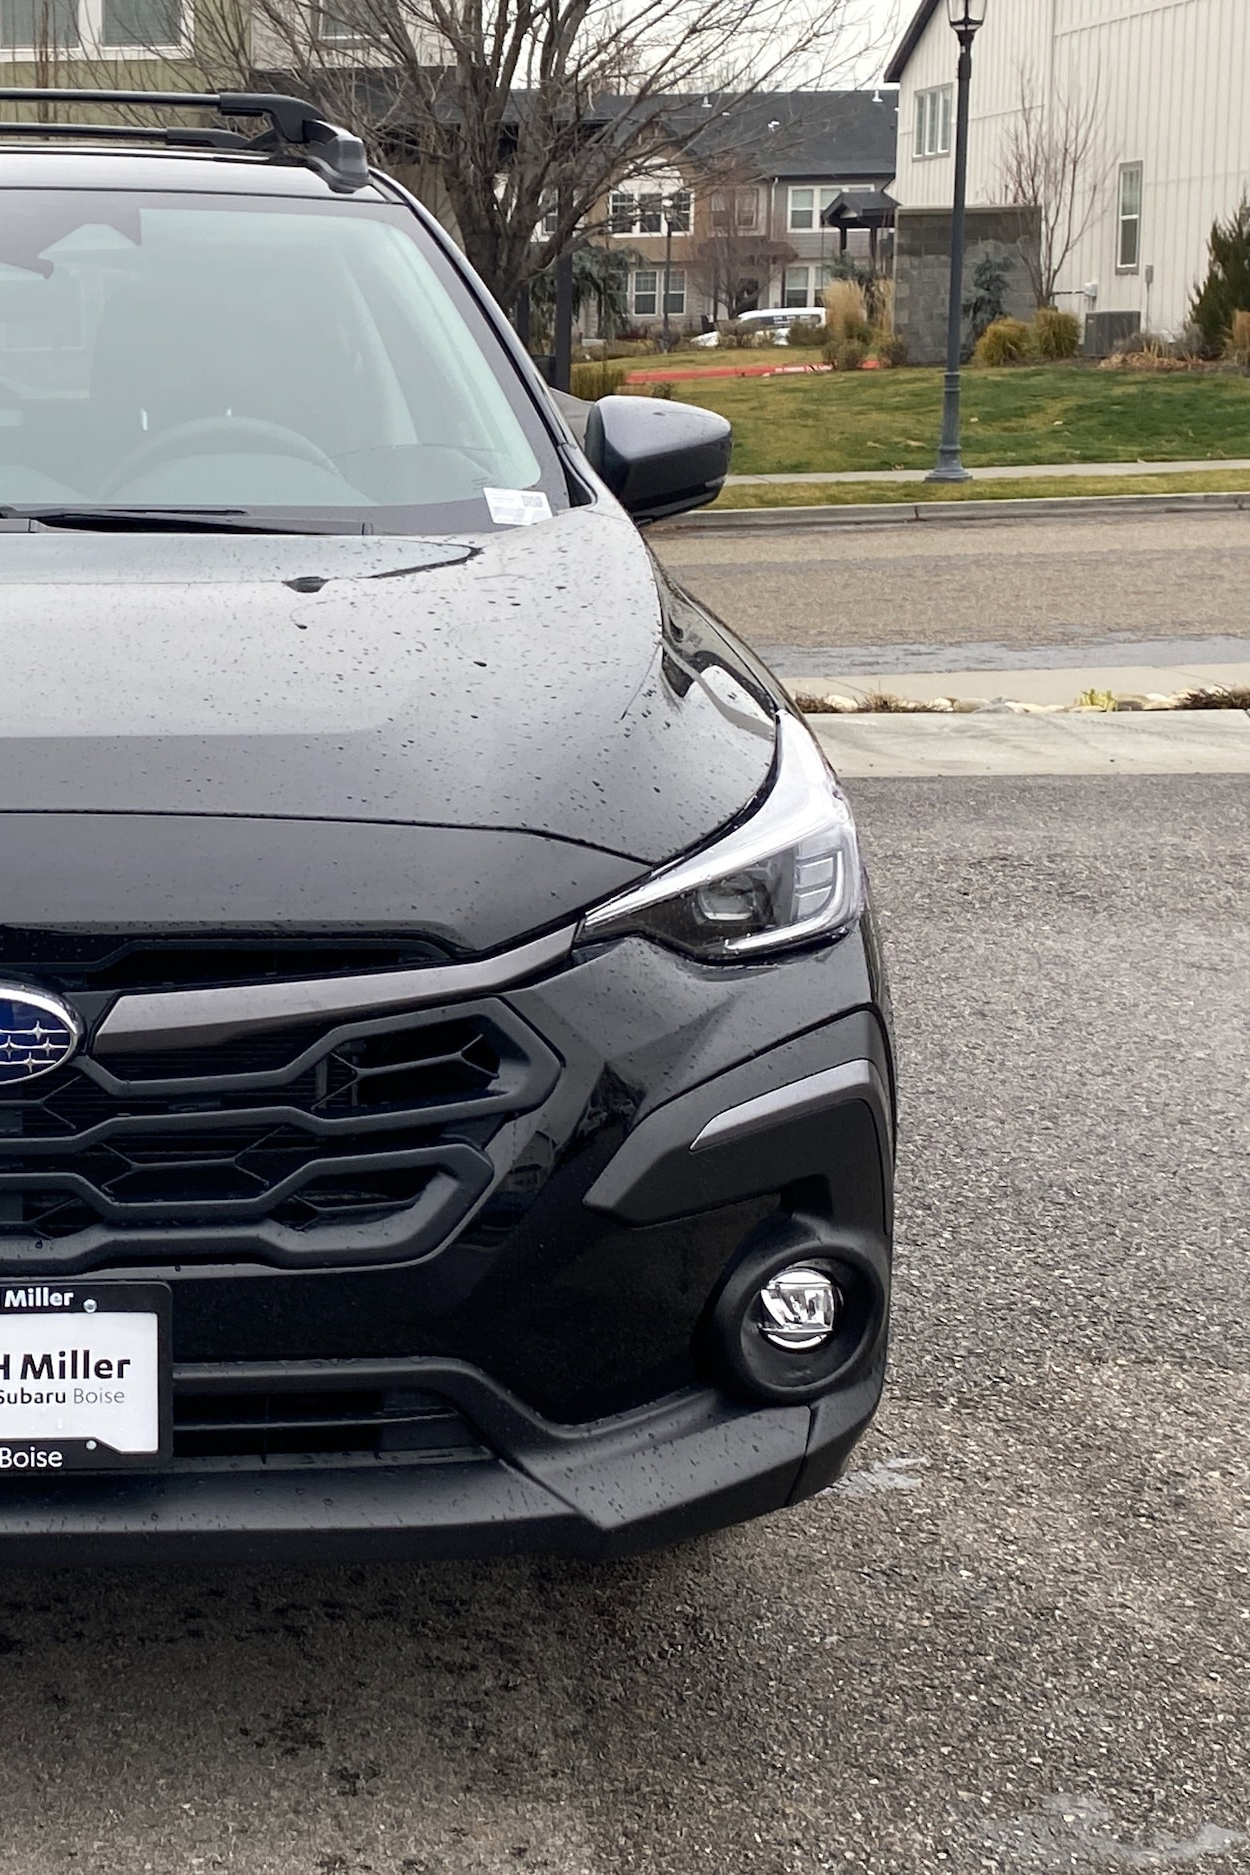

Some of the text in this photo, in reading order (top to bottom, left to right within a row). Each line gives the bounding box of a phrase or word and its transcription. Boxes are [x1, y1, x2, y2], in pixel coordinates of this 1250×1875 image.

[4, 1287, 74, 1308] Miller
[20, 1349, 131, 1381] Miller
[73, 1387, 125, 1405] Boise
